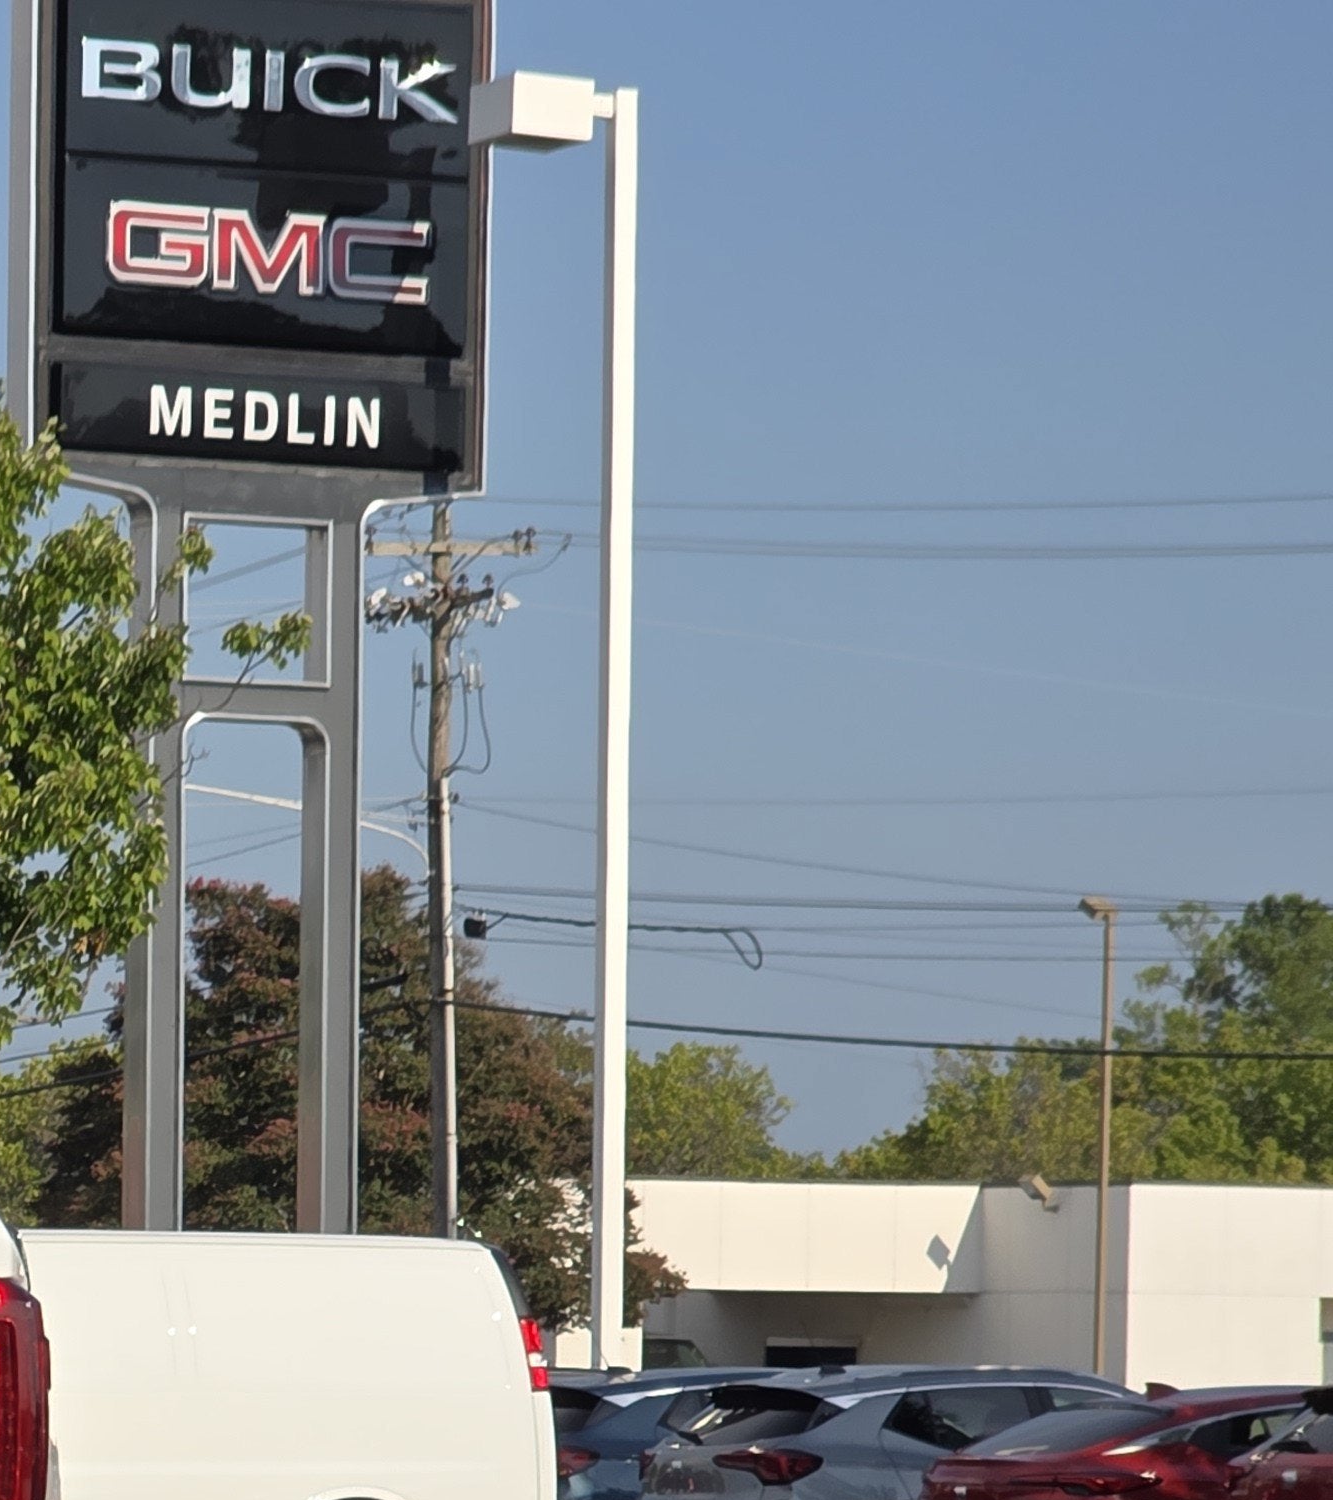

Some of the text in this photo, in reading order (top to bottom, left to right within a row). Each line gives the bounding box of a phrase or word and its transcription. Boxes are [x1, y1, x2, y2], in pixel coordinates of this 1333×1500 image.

[82, 35, 458, 124] BUICK
[108, 199, 432, 305] GMC
[149, 384, 381, 449] MEDLIN
